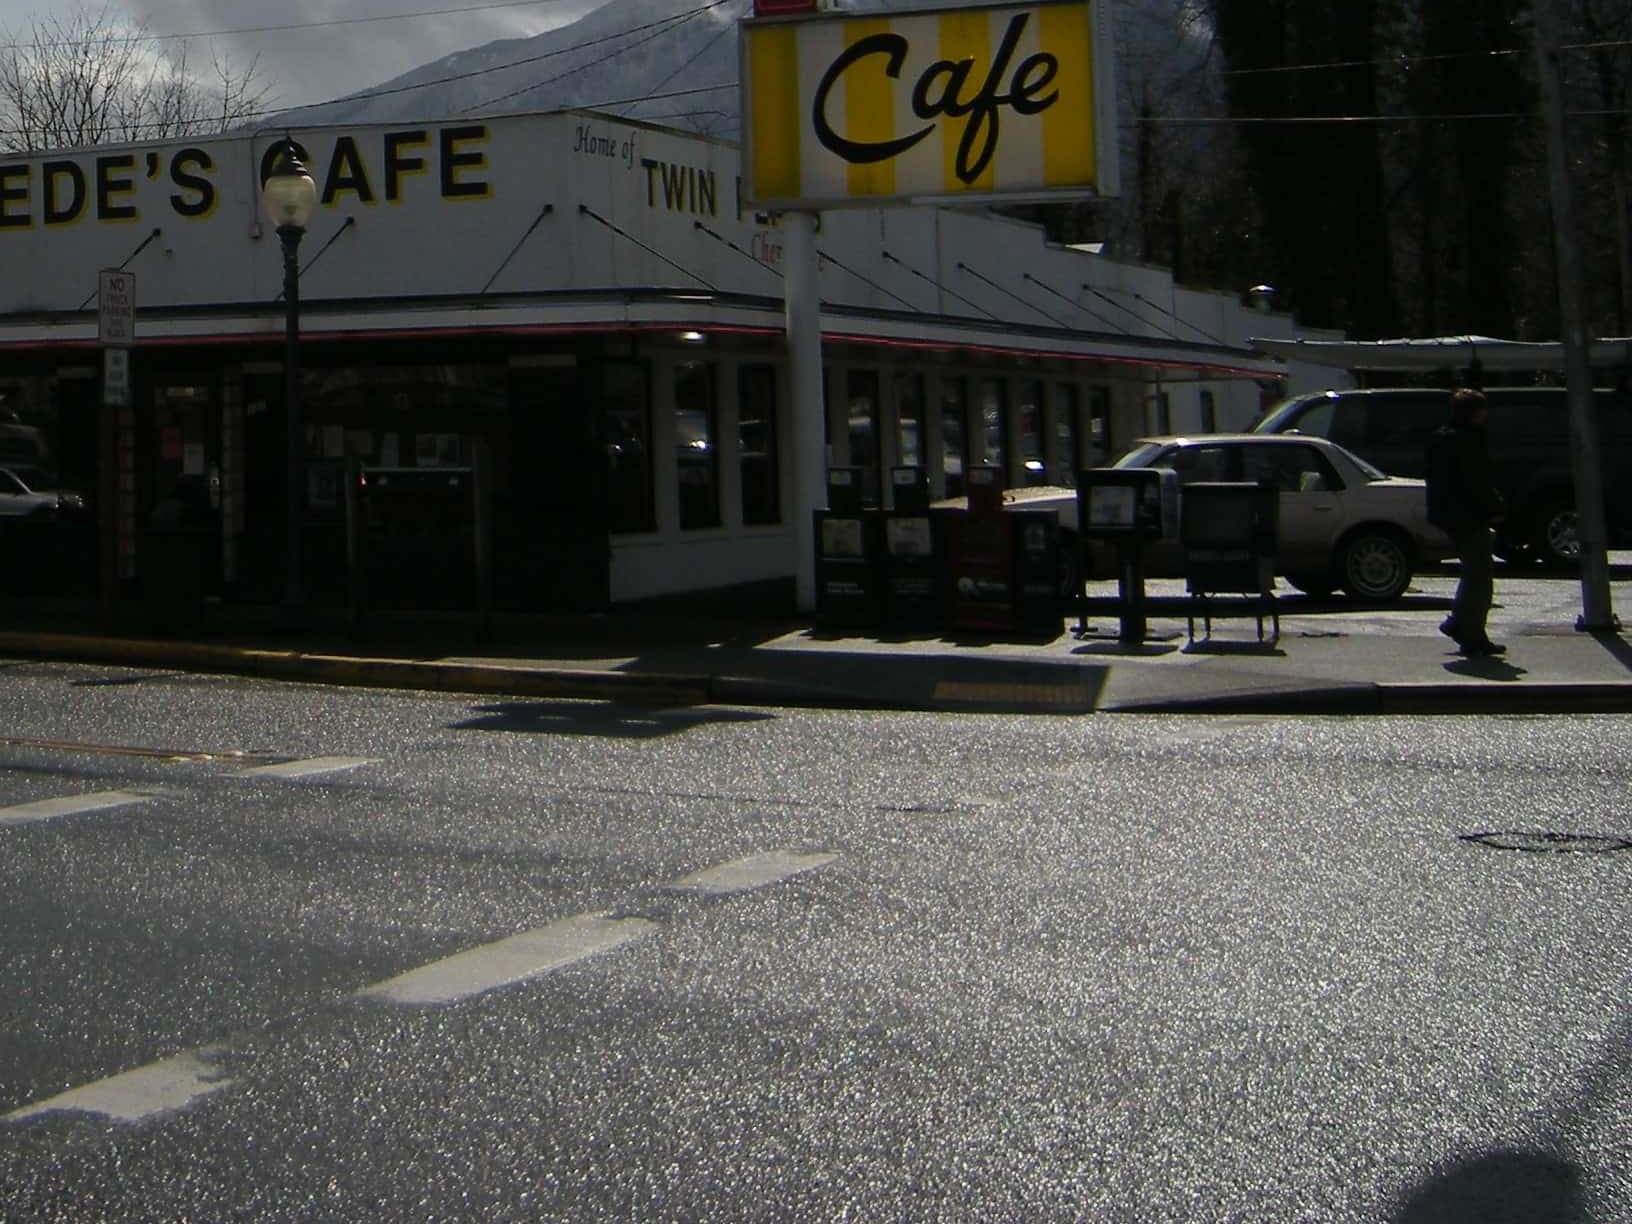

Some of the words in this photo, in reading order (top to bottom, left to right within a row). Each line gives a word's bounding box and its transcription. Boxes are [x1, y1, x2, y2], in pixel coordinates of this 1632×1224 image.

[813, 13, 1060, 184] Cafe
[573, 125, 617, 158] Home
[621, 130, 637, 171] of
[641, 157, 718, 218] TWIN
[110, 278, 125, 292] NO
